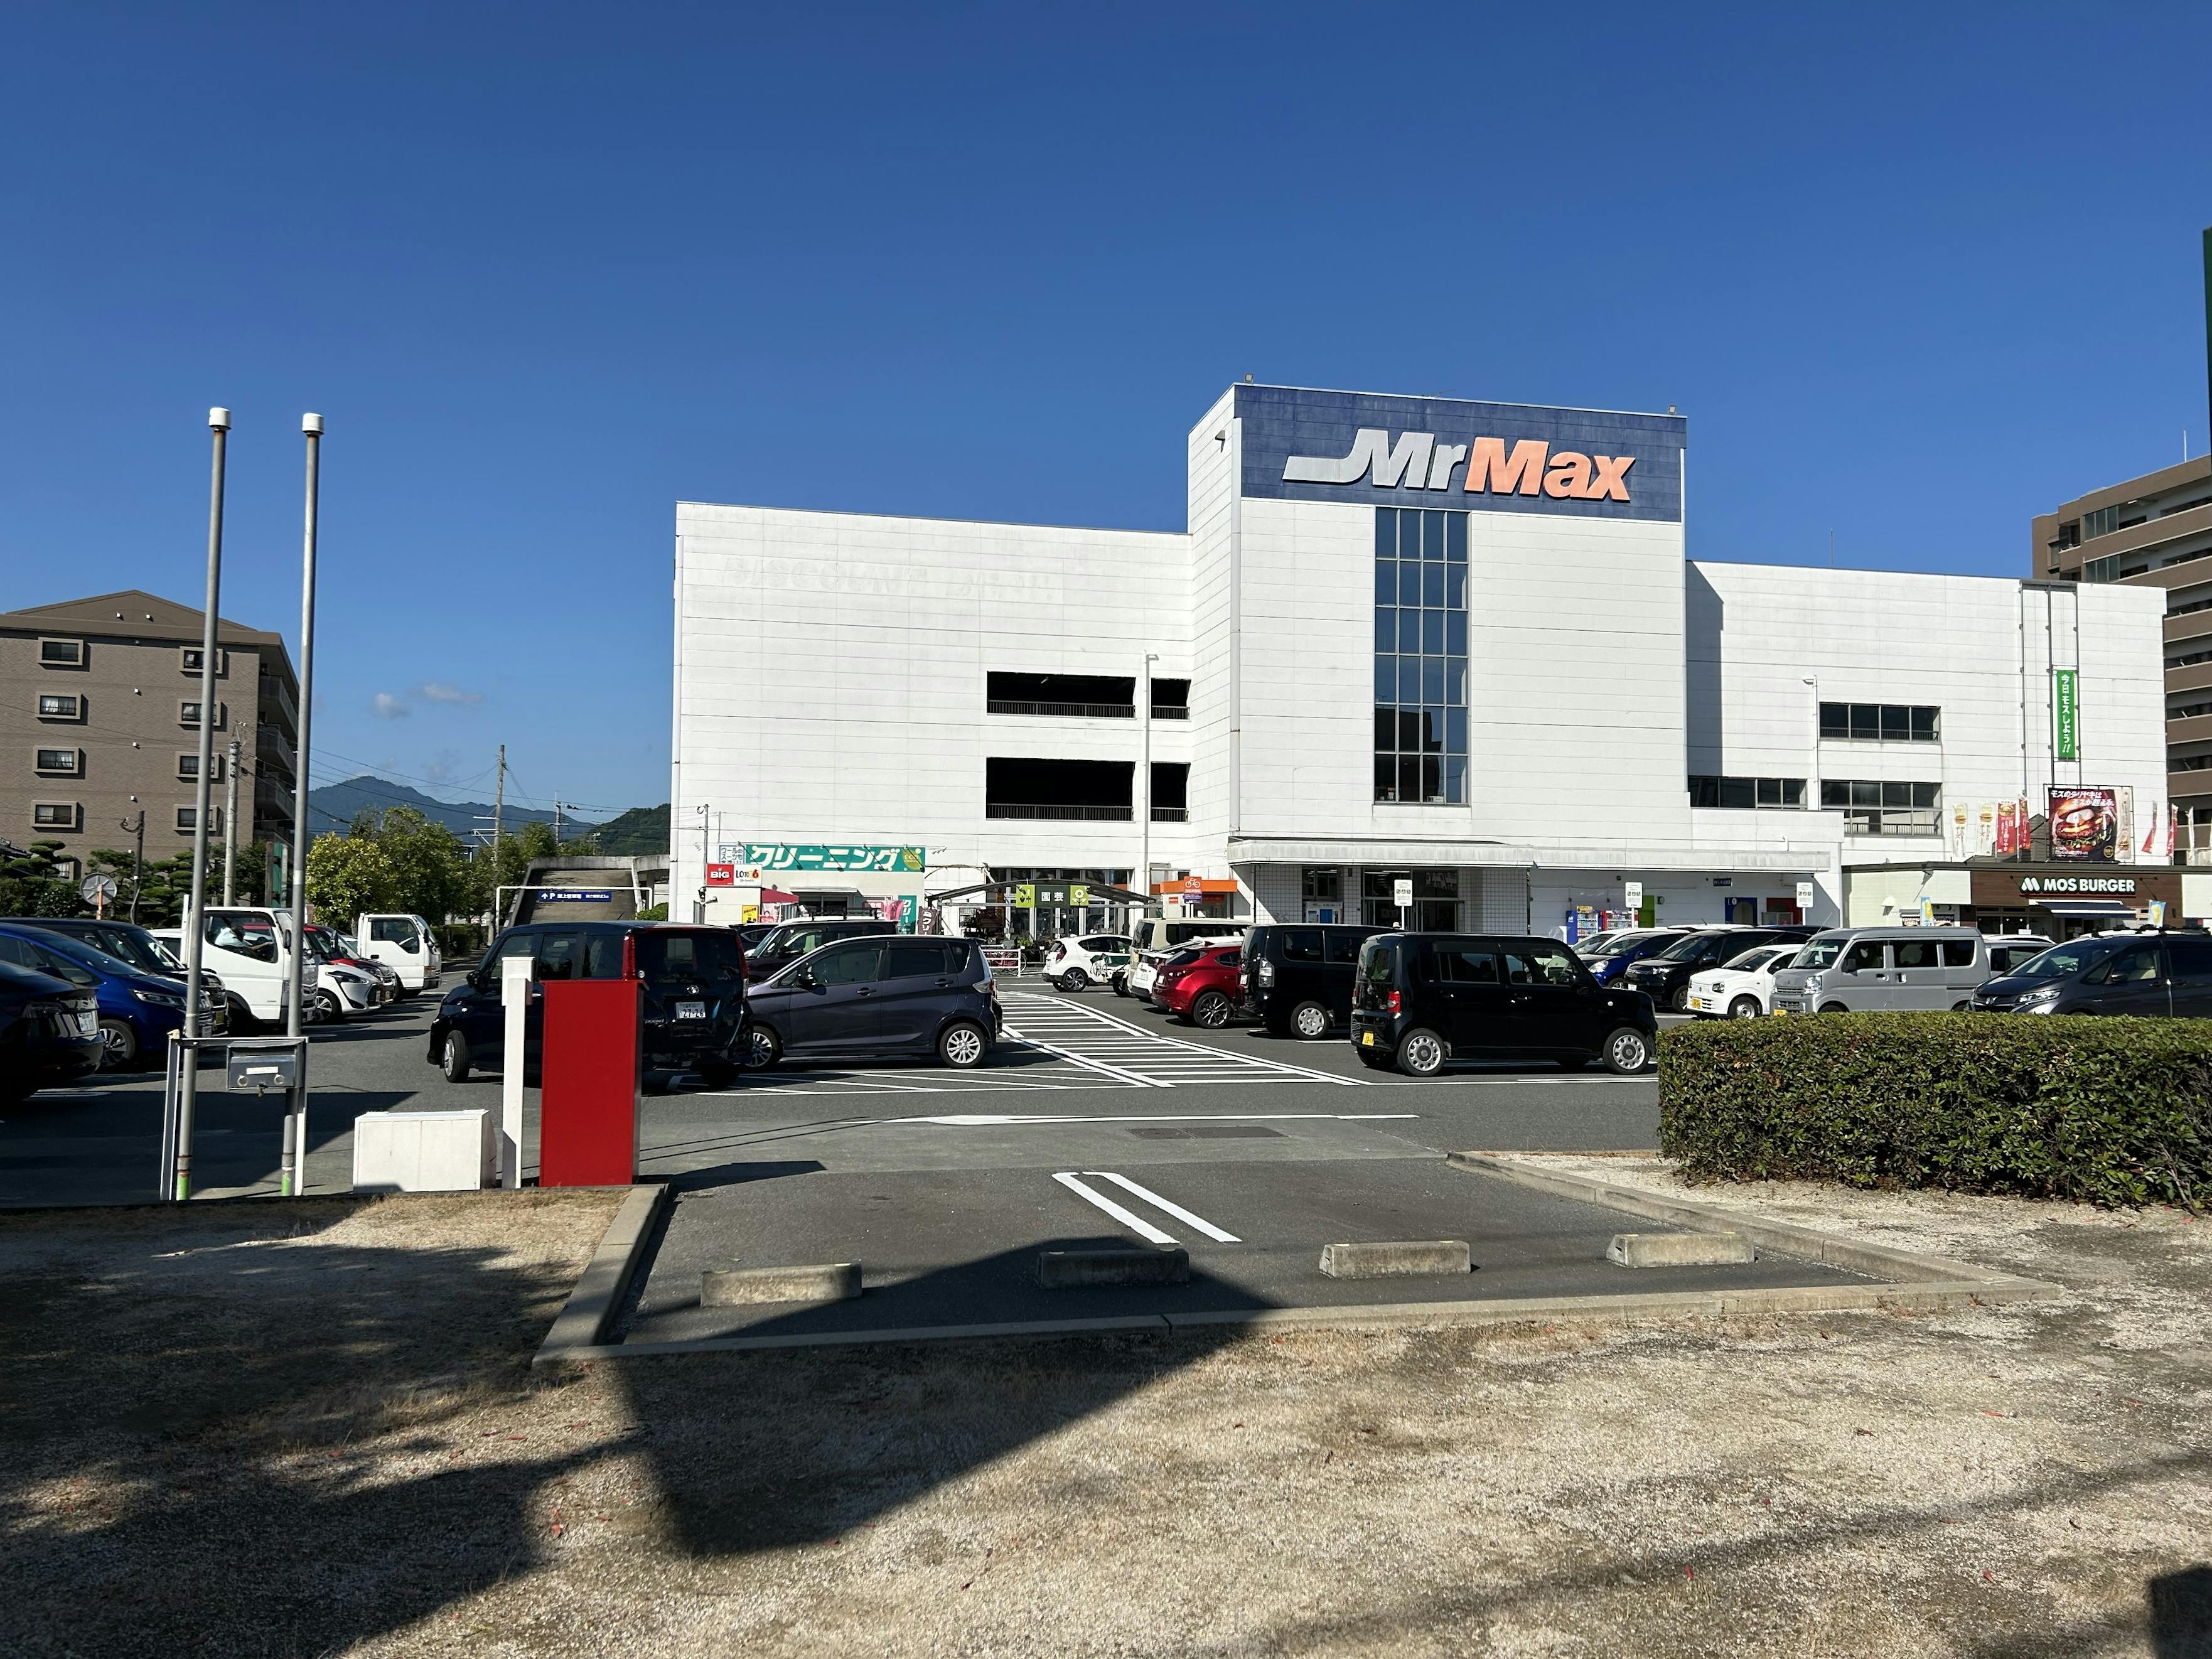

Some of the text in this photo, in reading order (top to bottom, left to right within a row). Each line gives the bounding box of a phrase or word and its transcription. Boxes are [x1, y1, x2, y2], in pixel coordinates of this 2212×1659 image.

[1281, 427, 1636, 502] MrMax
[750, 846, 901, 871] クリーニング
[2043, 879, 2135, 893] MOS BURGER
[1041, 891, 1063, 902] 園芸
